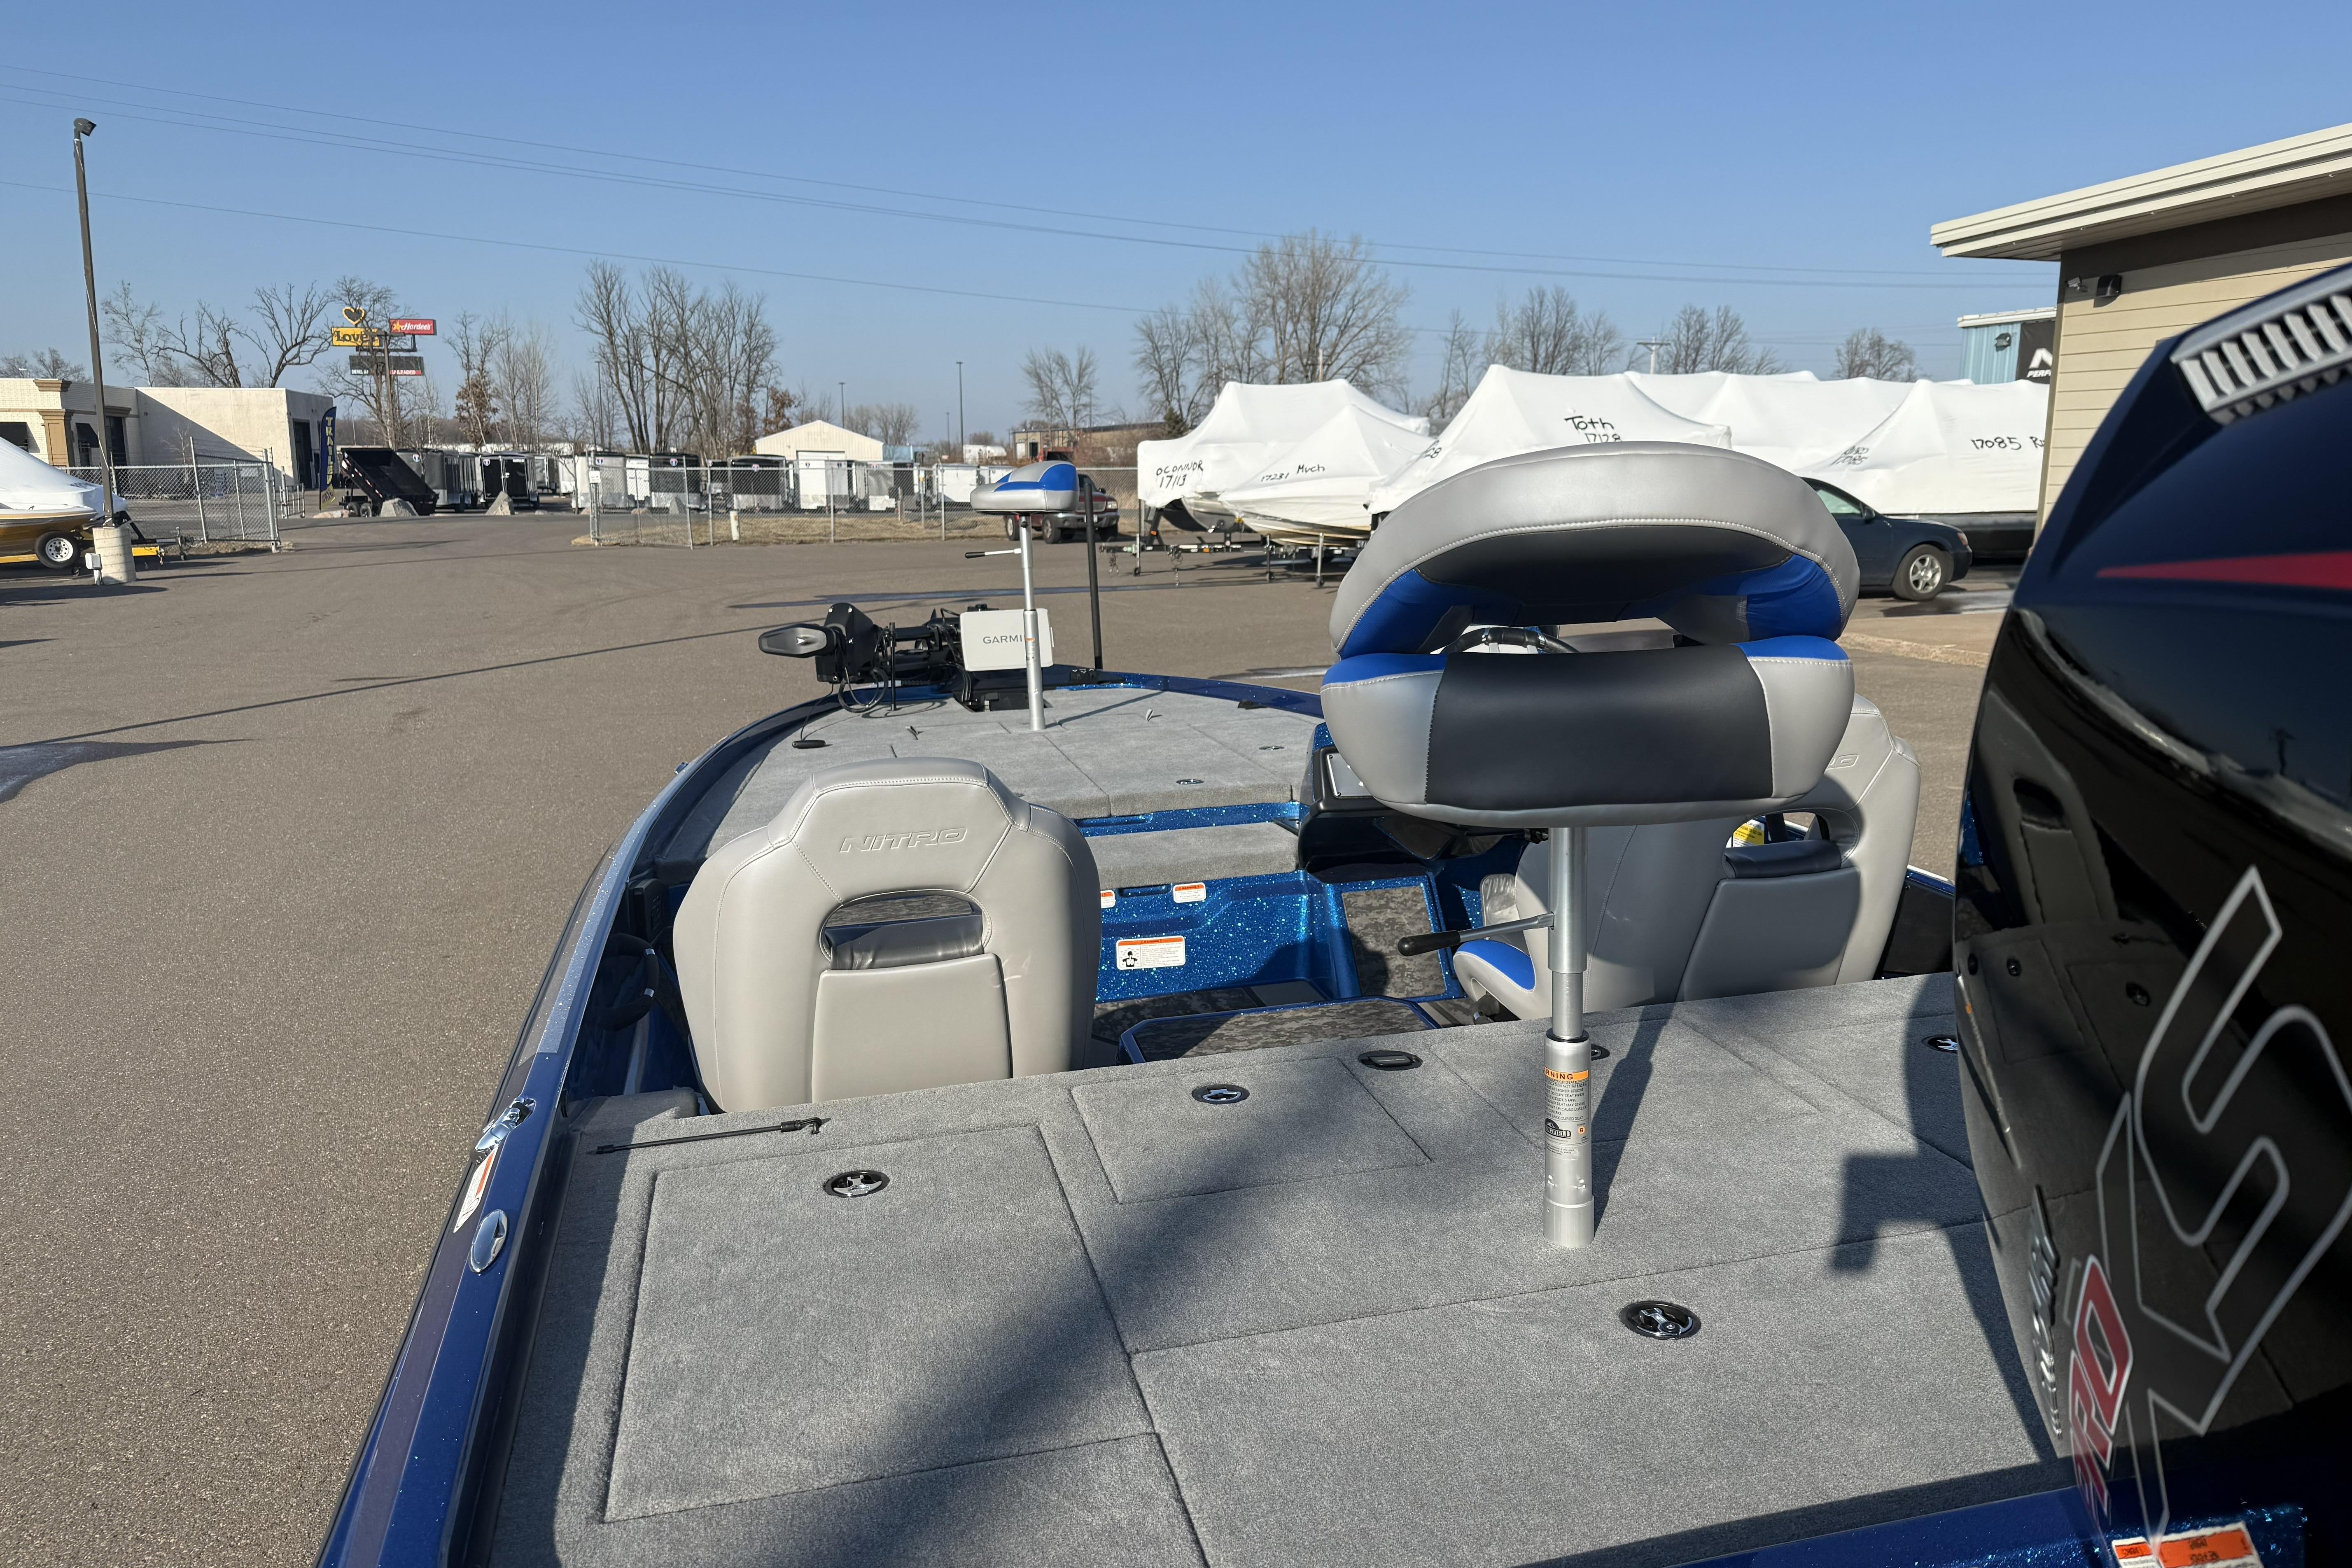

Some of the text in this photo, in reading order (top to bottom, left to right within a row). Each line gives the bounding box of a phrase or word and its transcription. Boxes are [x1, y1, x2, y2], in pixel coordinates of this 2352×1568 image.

[1564, 415, 1615, 433] Toth
[1970, 436, 2021, 450] 17085
[983, 635, 1022, 644] GARMI
[1544, 1068, 1573, 1080] RNING
